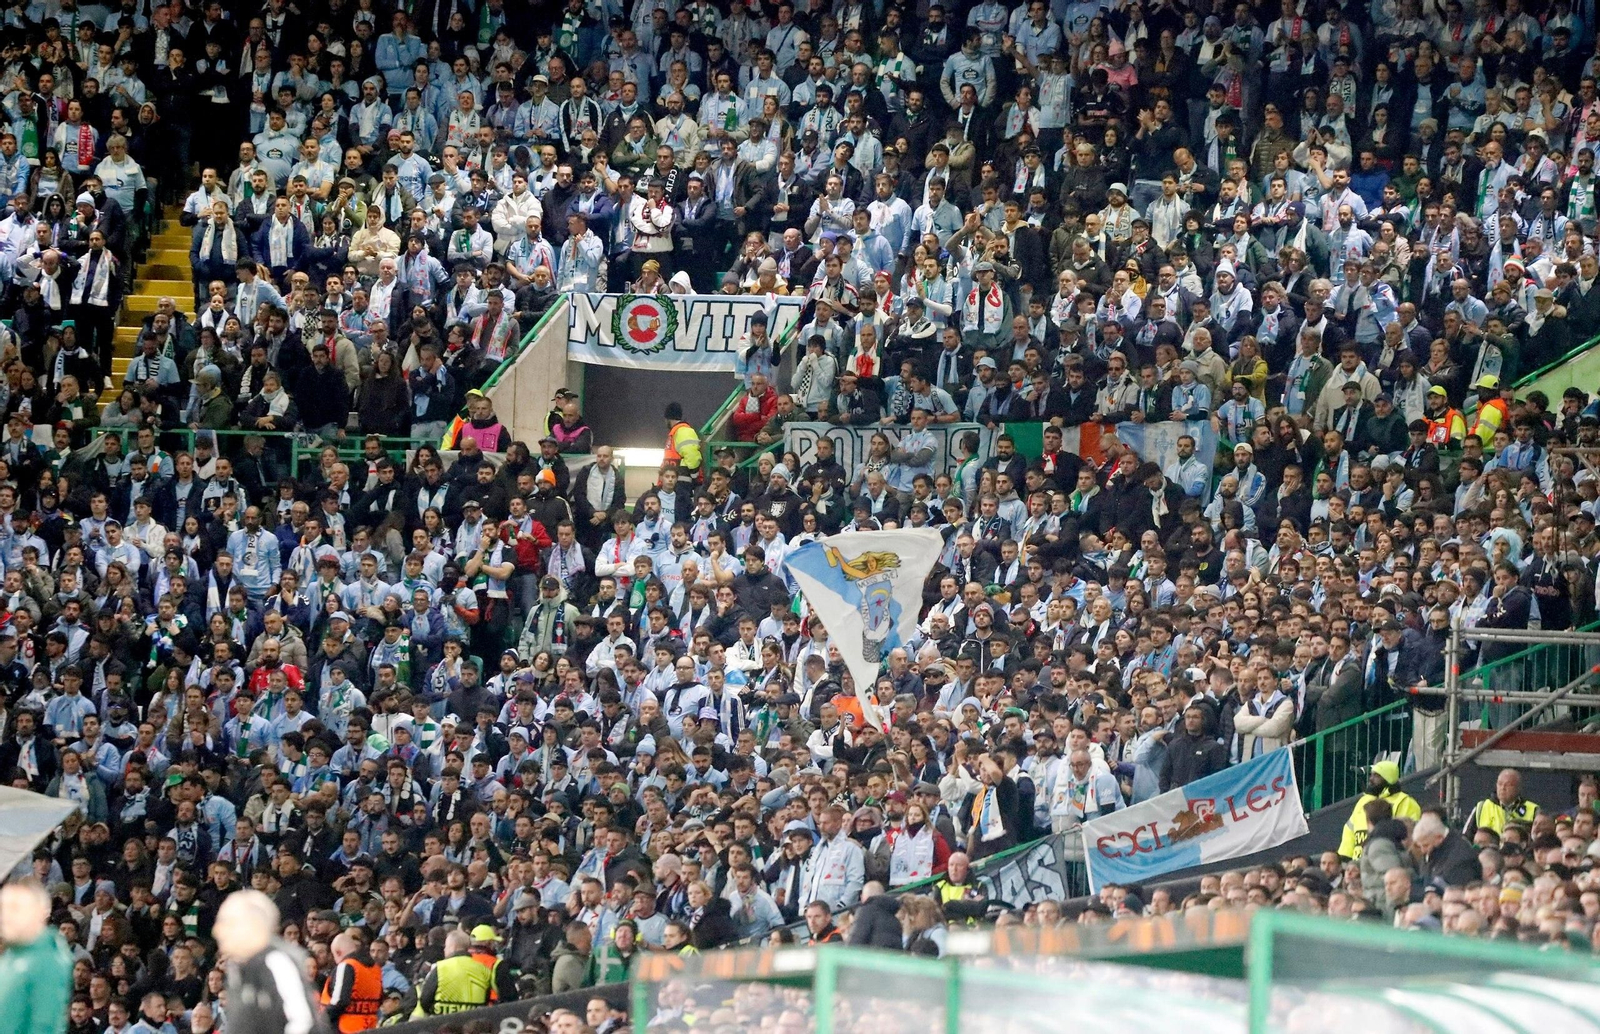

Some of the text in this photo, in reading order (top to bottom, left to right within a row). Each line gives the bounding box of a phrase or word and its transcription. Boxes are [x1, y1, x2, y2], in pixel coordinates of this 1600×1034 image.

[664, 168, 678, 193] CELTA
[1225, 775, 1287, 822] LES
[434, 1002, 473, 1015] STEW
